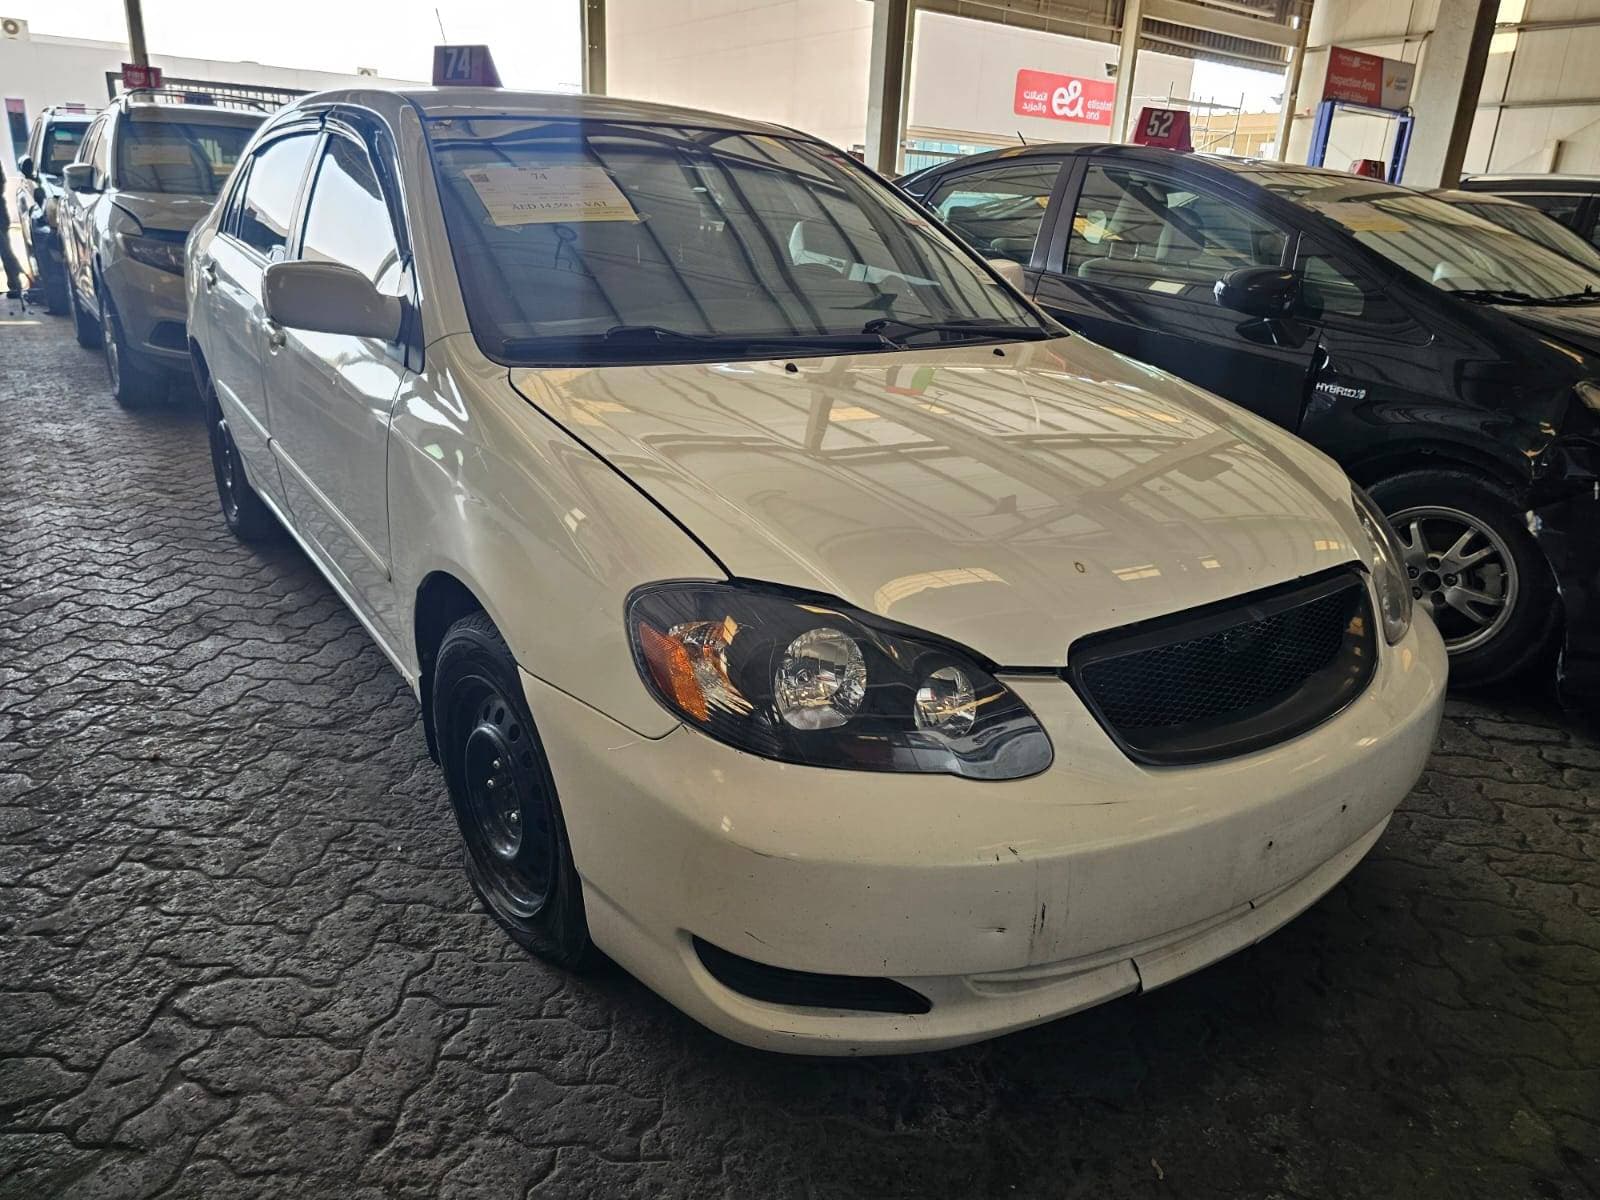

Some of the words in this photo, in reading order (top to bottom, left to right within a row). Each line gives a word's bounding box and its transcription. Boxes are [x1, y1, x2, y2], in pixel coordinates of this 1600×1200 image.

[444, 48, 471, 79] 74
[1086, 111, 1100, 120] and
[1146, 110, 1174, 138] 52
[531, 172, 549, 182] 74
[1315, 382, 1356, 398] HYBRID
